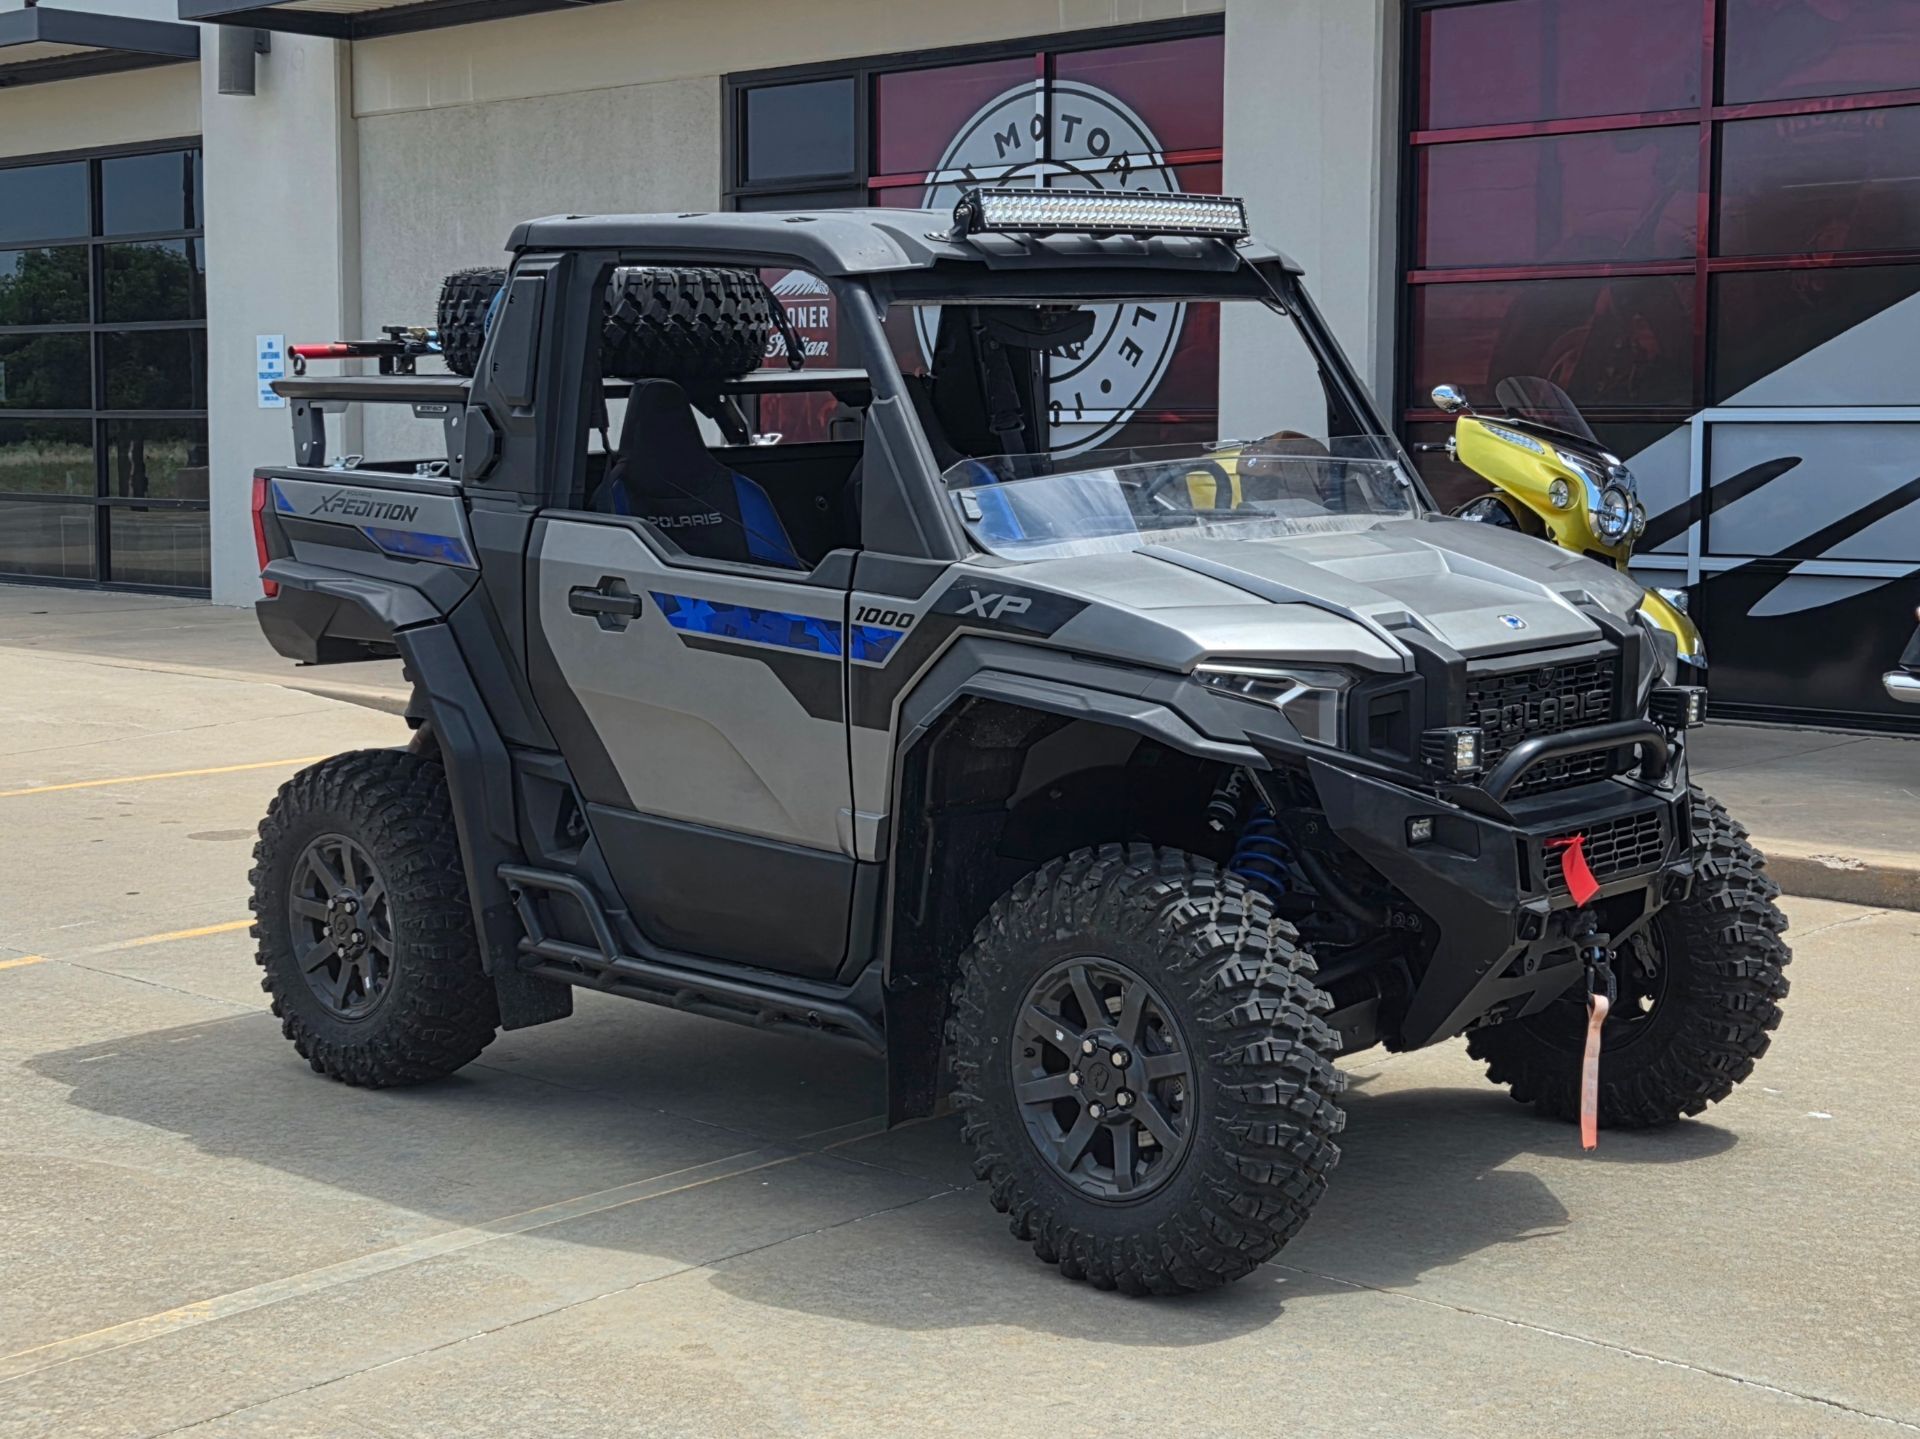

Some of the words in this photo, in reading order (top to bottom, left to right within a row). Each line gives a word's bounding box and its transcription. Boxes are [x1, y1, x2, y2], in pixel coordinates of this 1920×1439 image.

[768, 306, 829, 328] ONER
[765, 332, 829, 358] Inian
[309, 489, 419, 522] XPEDITION
[647, 512, 722, 528] POLARIS
[855, 606, 915, 629] 1000
[954, 590, 1032, 619] XP
[1480, 689, 1609, 732] POLARIS
